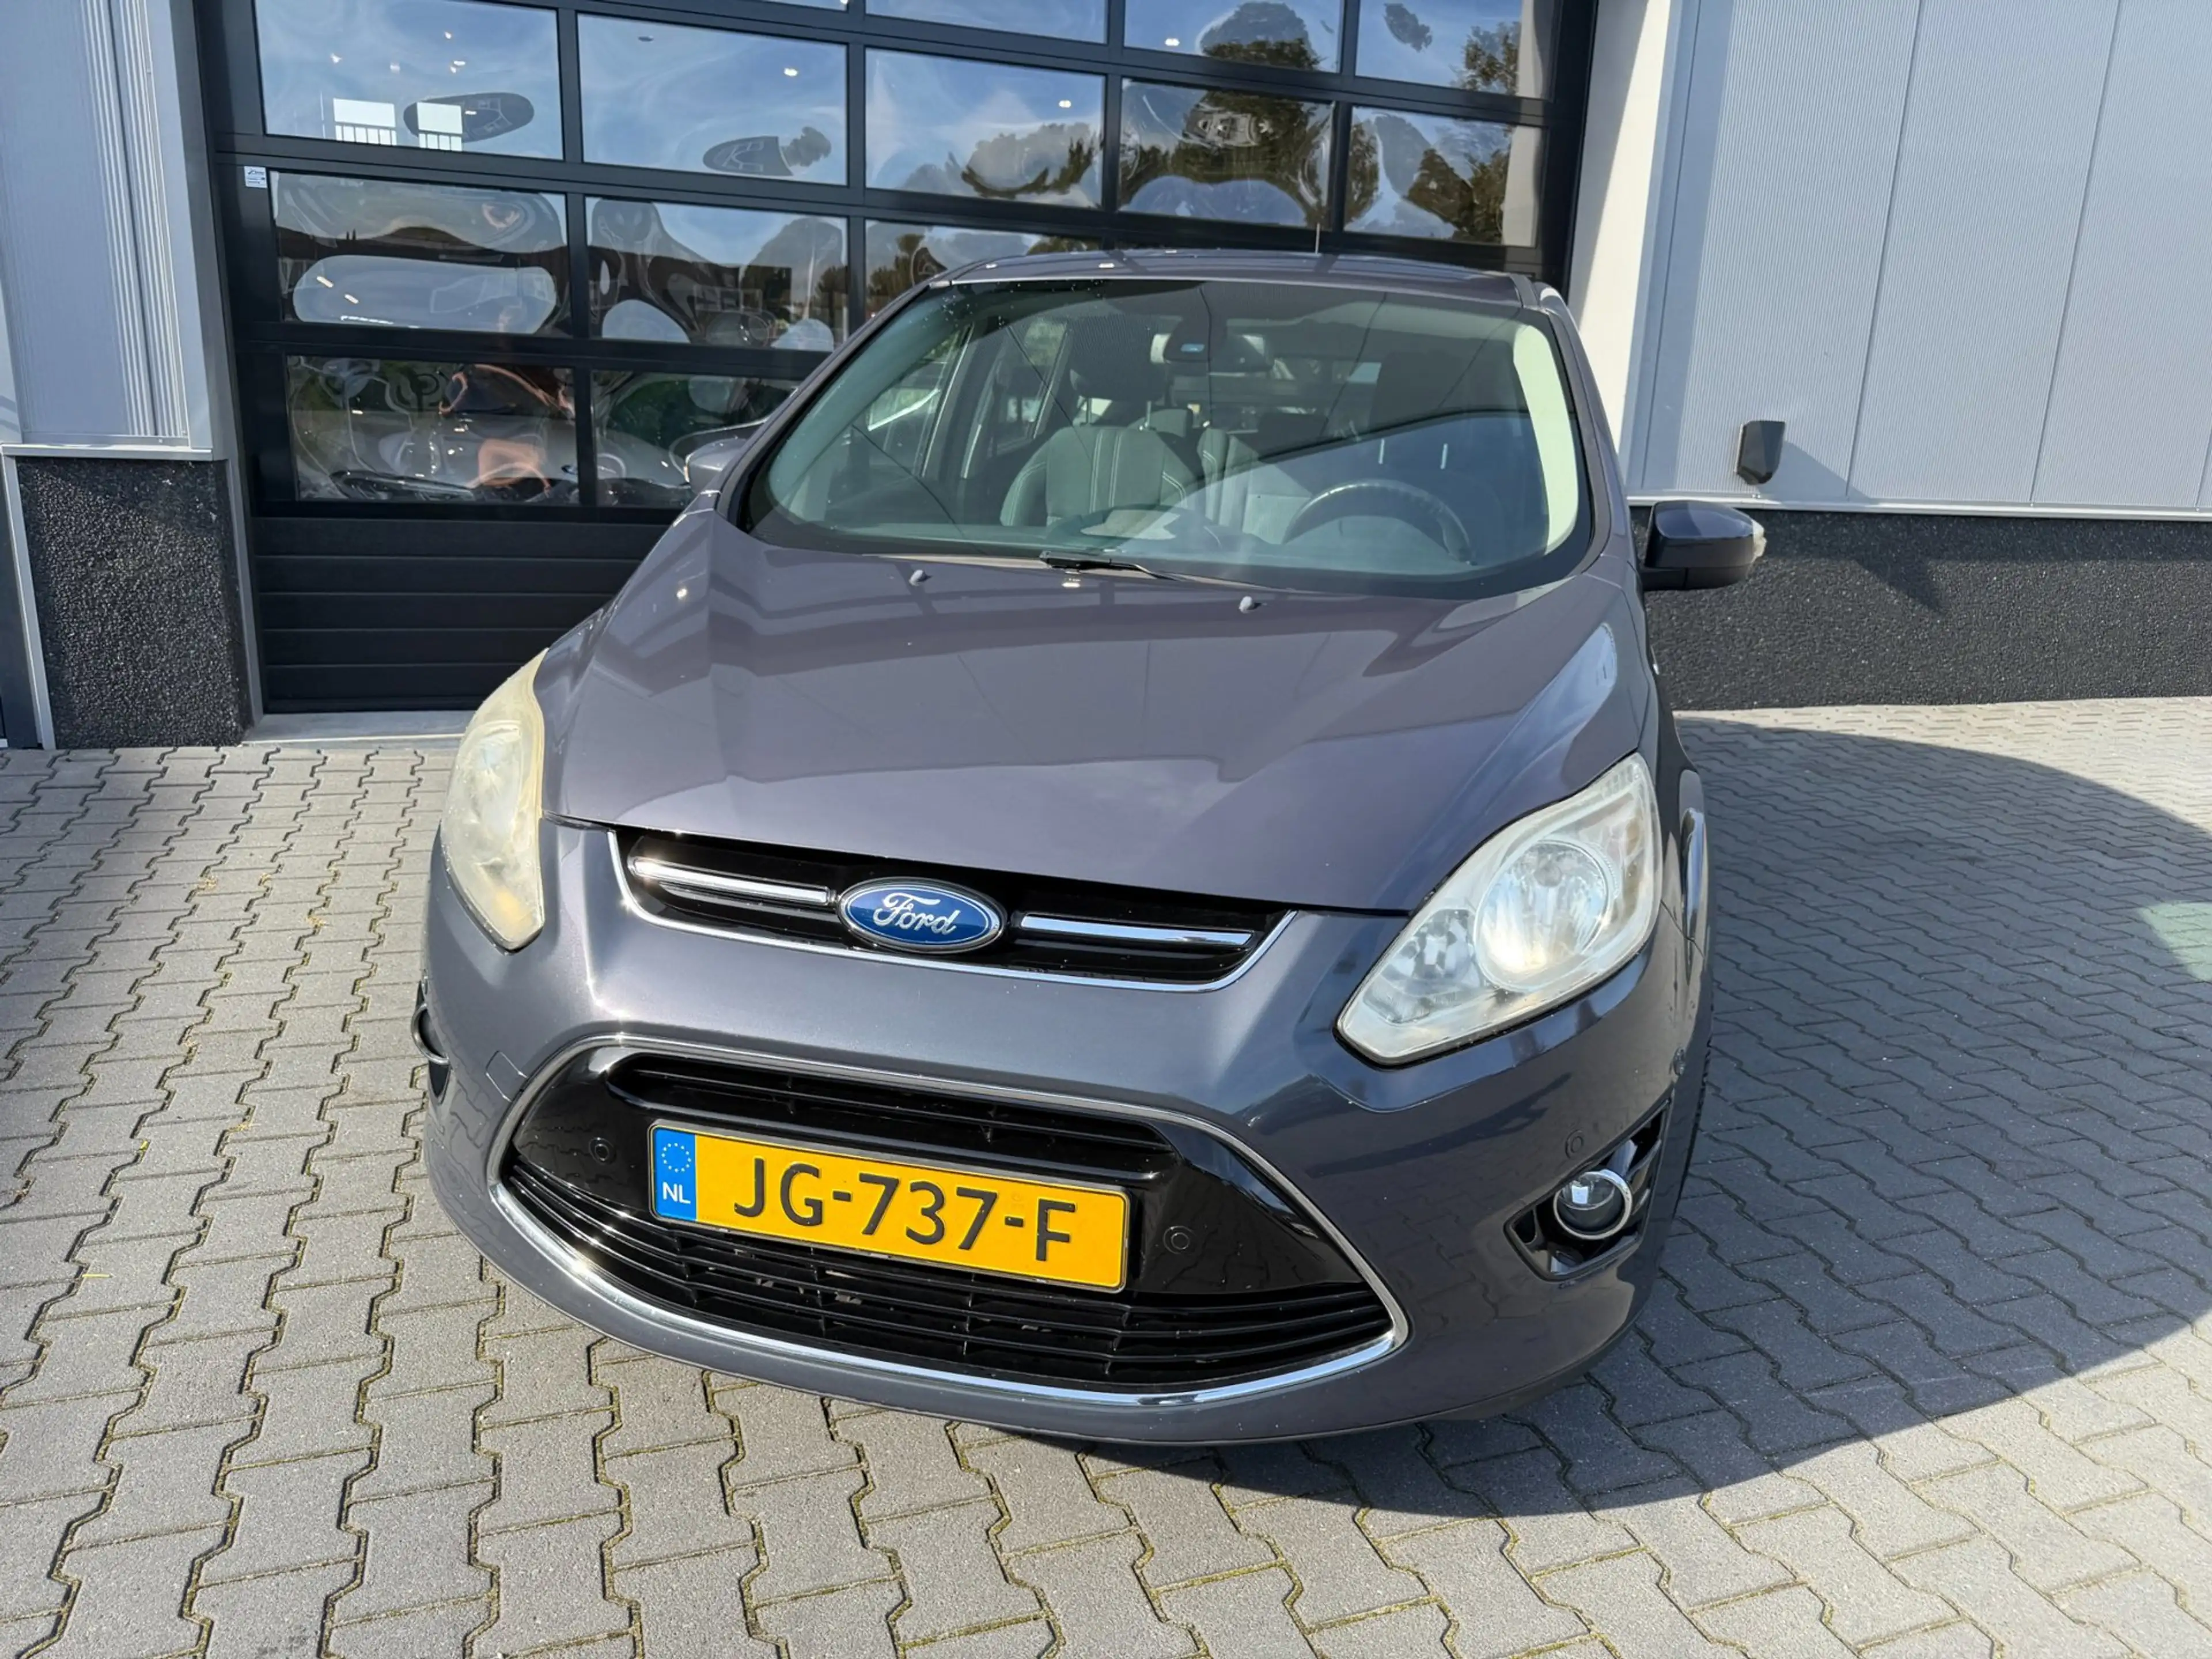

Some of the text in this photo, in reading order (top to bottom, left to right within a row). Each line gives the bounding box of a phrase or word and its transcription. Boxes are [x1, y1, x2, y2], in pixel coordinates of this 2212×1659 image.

[873, 892, 961, 935] Ford
[662, 1181, 691, 1205] NL
[733, 1157, 1077, 1262] JG-737-F
